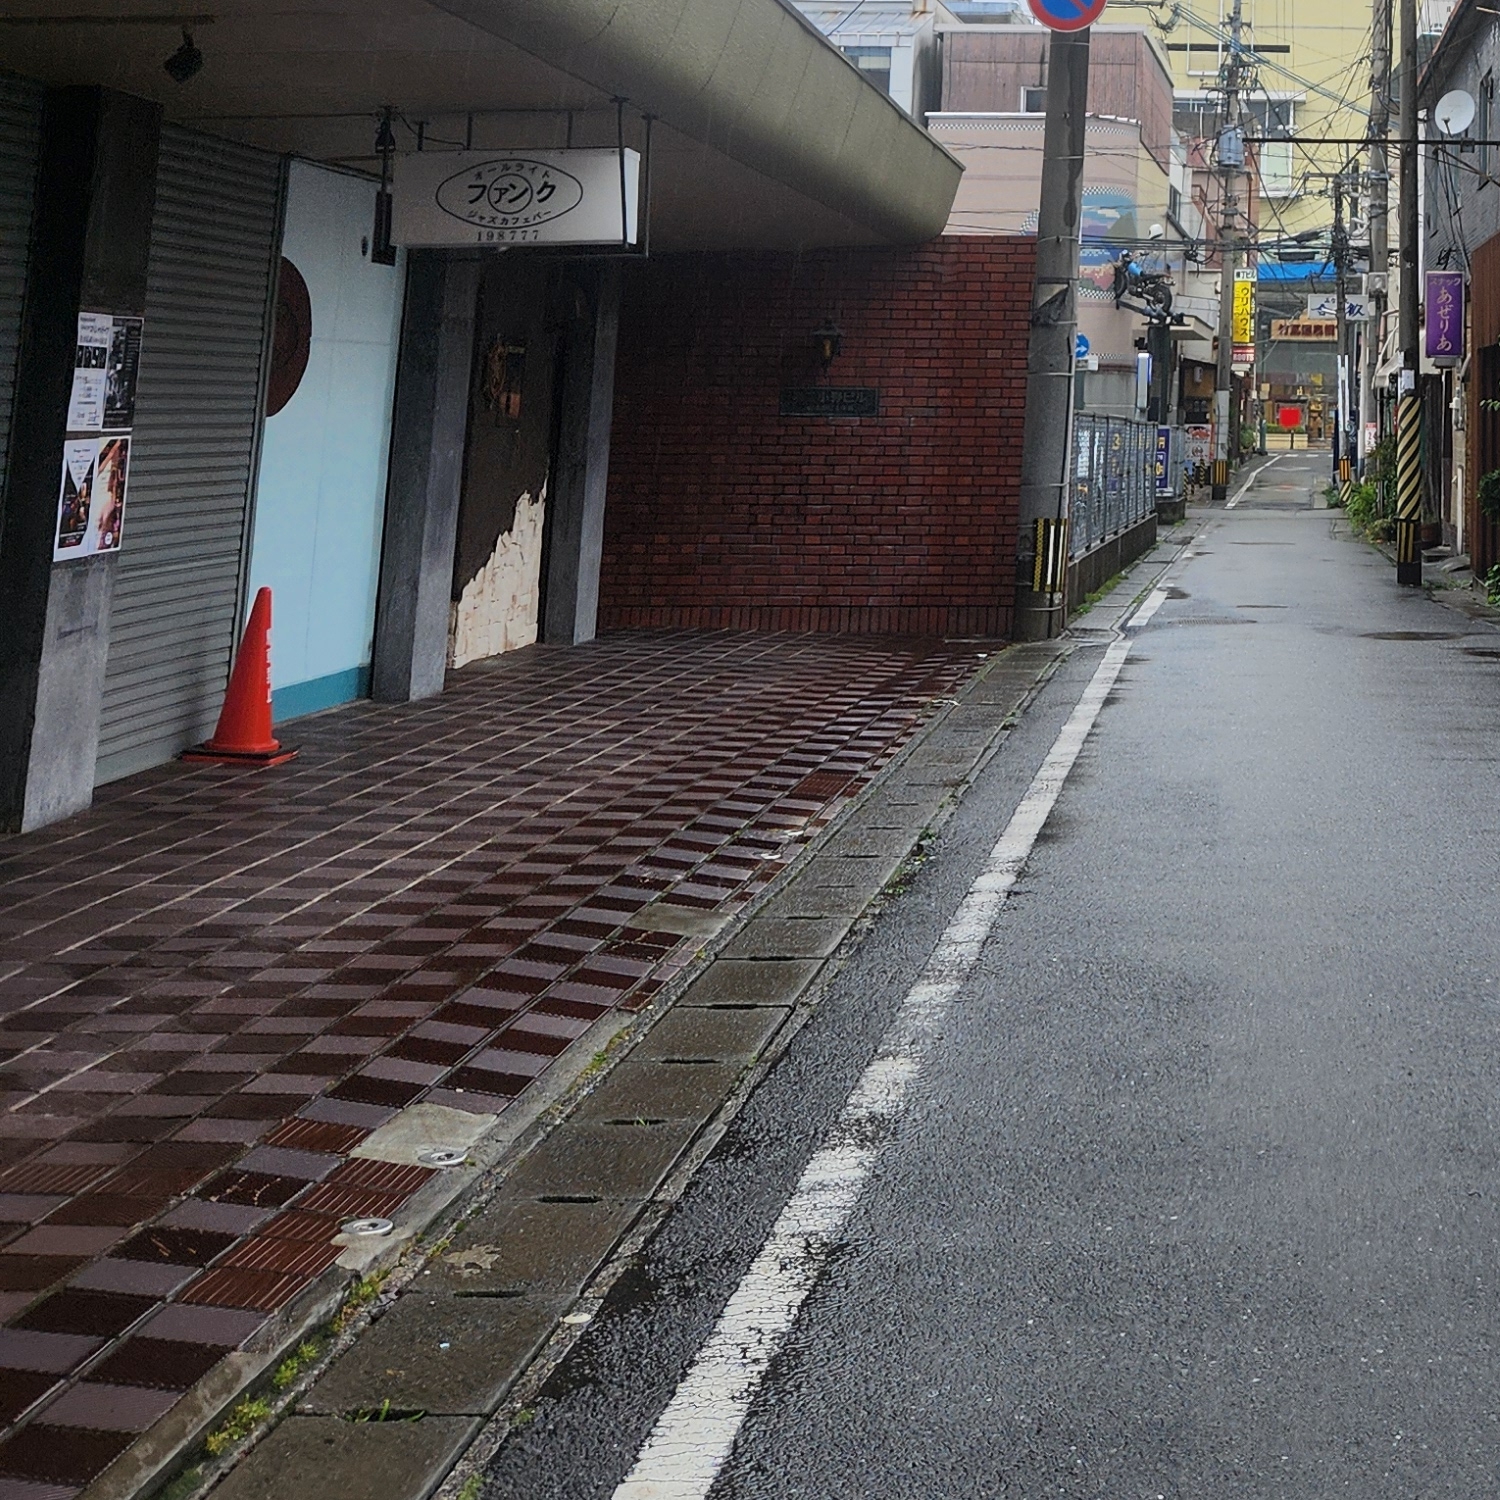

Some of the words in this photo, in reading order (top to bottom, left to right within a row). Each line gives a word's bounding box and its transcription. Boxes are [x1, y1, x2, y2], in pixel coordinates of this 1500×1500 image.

[473, 162, 551, 181] オールライト
[467, 182, 556, 204] ファンク
[467, 210, 552, 226] ジャズカフェバー
[477, 230, 540, 242] 198777
[1429, 277, 1461, 287] スナック
[1240, 287, 1250, 337] ウリハウス
[1436, 286, 1454, 351] あぜりあ
